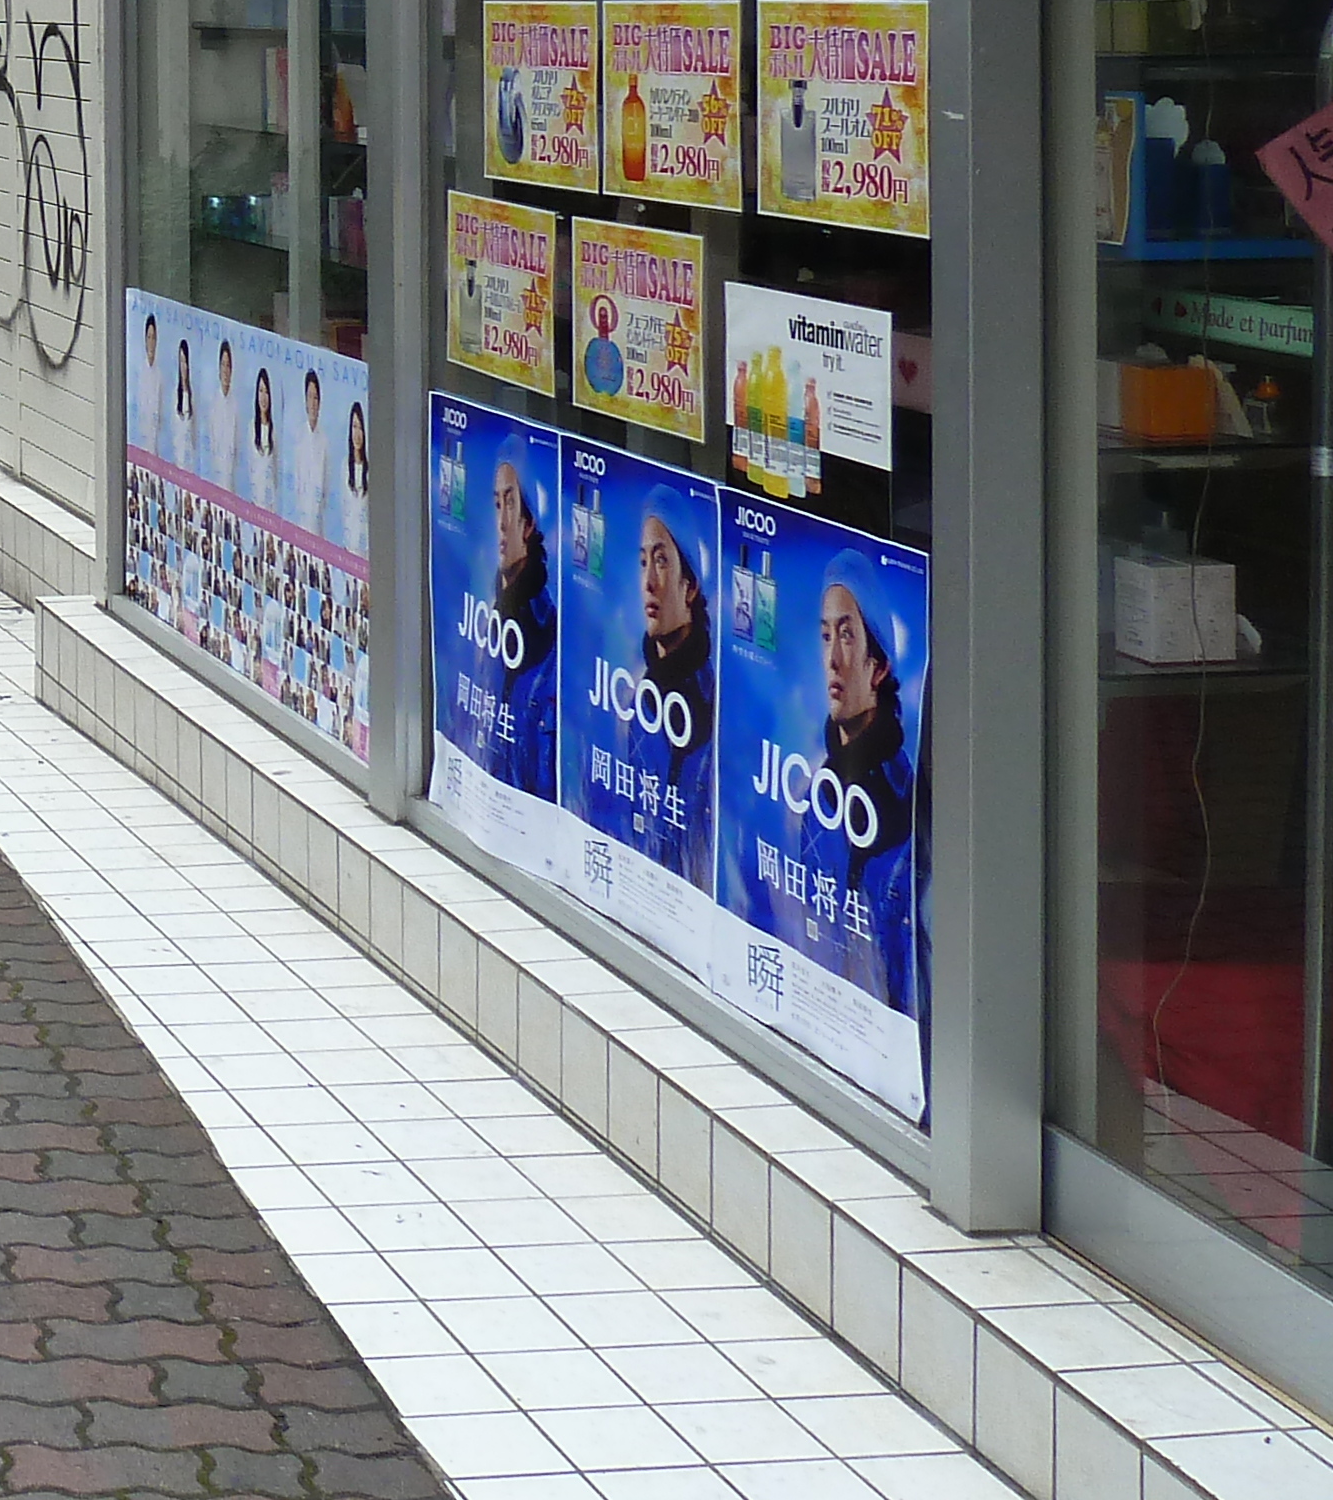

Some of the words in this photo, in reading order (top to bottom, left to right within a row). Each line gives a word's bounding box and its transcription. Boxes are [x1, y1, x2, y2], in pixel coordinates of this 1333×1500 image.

[491, 22, 516, 43] BIG
[549, 26, 589, 69] SALE
[613, 24, 642, 47] BIG
[682, 28, 731, 74] SALE
[769, 25, 806, 50] BIG
[857, 32, 916, 83] SALE
[564, 109, 584, 124] OFF
[702, 118, 725, 135] OFF
[872, 106, 904, 130] 71%
[539, 135, 589, 169] 2,980円
[659, 143, 720, 181] 2,980円
[872, 131, 901, 150] OFF
[831, 160, 908, 204] 2,980円
[455, 213, 479, 235] BIG
[509, 229, 547, 275] SALE
[581, 240, 609, 266] BIG
[648, 255, 693, 307] SALE
[491, 325, 538, 367] 2,980円
[788, 313, 884, 358] vitaminwater
[1239, 316, 1254, 332] et
[666, 346, 689, 366] OFF
[635, 368, 694, 414] 2,980円
[442, 405, 468, 431] JICOO
[573, 449, 606, 477] JICOO
[735, 505, 777, 537] JICOO
[458, 590, 525, 670] JICOO
[456, 670, 517, 745] 岡田将生
[588, 656, 693, 748] JICOO
[591, 743, 688, 832] 岡田将生
[751, 738, 878, 848] JICOO
[583, 838, 613, 900] 瞬
[756, 836, 873, 942] 岡田将生
[747, 942, 785, 1013] 瞬
